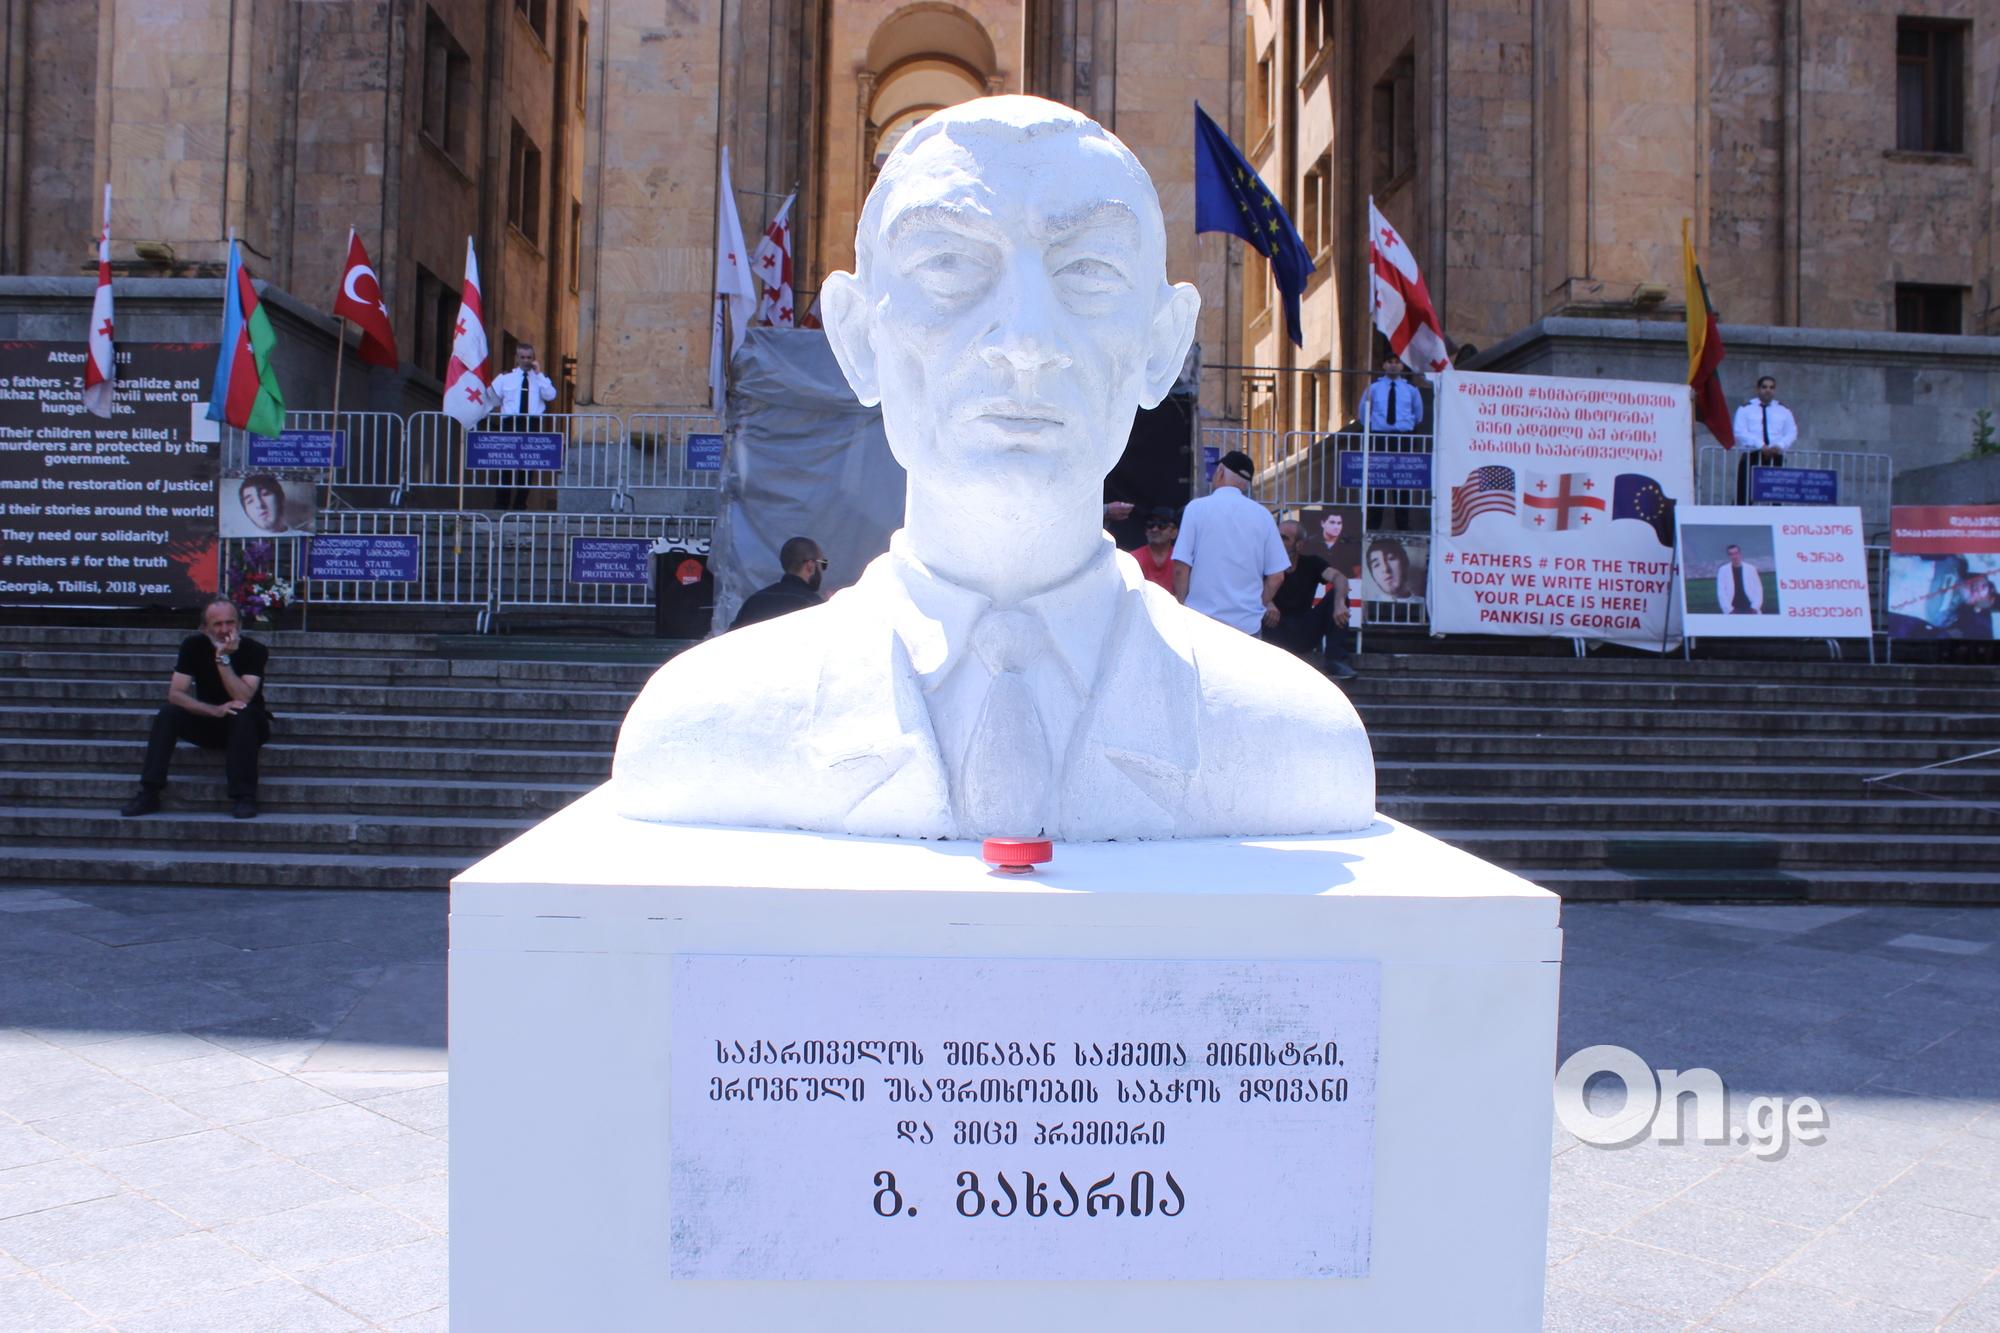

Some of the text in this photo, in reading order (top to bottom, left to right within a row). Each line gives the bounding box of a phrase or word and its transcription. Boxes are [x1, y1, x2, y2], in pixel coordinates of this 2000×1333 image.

[12, 376, 61, 388] fathers
[174, 378, 200, 389] and
[144, 392, 178, 402] went
[181, 393, 198, 402] on
[0, 428, 33, 439] Their
[37, 428, 92, 439] children
[95, 430, 129, 440] were
[132, 428, 168, 440] killed
[0, 440, 208, 455] murderers are protected by the
[44, 455, 130, 466] government.
[42, 478, 65, 490] the
[68, 479, 142, 491] restoration
[146, 480, 160, 491] of
[162, 480, 214, 493] Justice!
[8, 504, 42, 515] their
[44, 504, 92, 516] stories
[94, 504, 142, 516] around
[146, 505, 168, 516] the
[172, 506, 214, 517] world!
[2, 529, 169, 544] They need our solidarity!
[2, 555, 168, 568] # Fathers # for the truth
[326, 560, 392, 568] SPECIAL STATE
[594, 562, 630, 570] SPECIAL
[1444, 552, 1680, 576] # FATHERS # FOR THE TRUTH
[313, 568, 404, 577] PROTECTION SERVICE
[582, 570, 635, 579] PROTECTION
[0, 581, 172, 596] Georgia, Tbilisi, 2018 year.
[1451, 570, 1671, 594] TODAY WE WRITE HISTORY!
[1474, 590, 1648, 612] YOUR PLACE IS HERE!
[1480, 609, 1641, 630] PANKISI IS GEORGIA
[714, 1039, 1345, 1069] საქართველოს შინაგან საქმეთა მინისტრი,
[708, 1075, 1348, 1104] ეროვნული უსაფრთხოების საბჭოს მდივანი
[896, 1120, 1166, 1146] და ვიცე პრემიერი
[873, 1170, 1187, 1218] გ. გახარია
